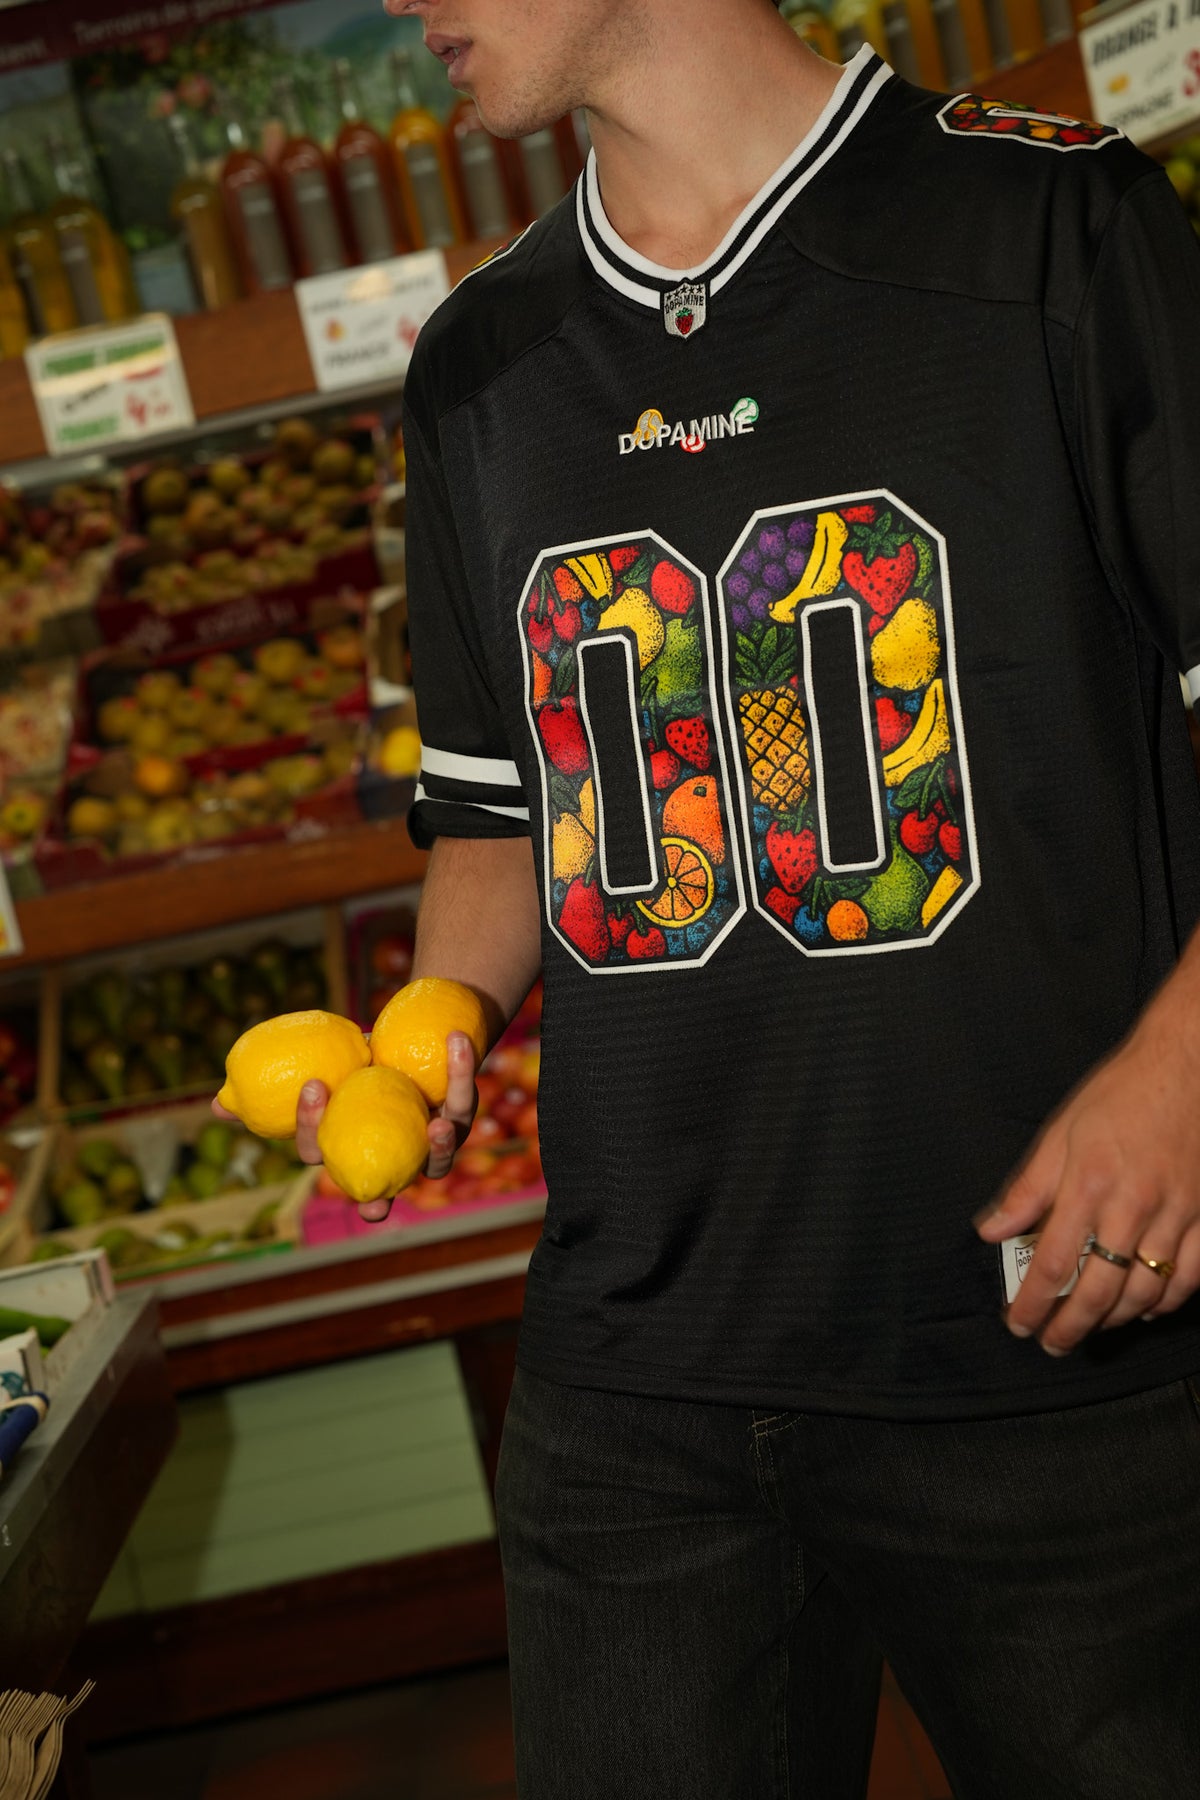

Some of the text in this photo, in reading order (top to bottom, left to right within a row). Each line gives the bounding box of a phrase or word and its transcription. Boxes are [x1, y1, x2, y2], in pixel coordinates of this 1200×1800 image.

[664, 294, 705, 315] DOPAMINE
[618, 397, 760, 455] DOPAMINE
[517, 488, 981, 975] 00
[1018, 1255, 1032, 1267] DOP
